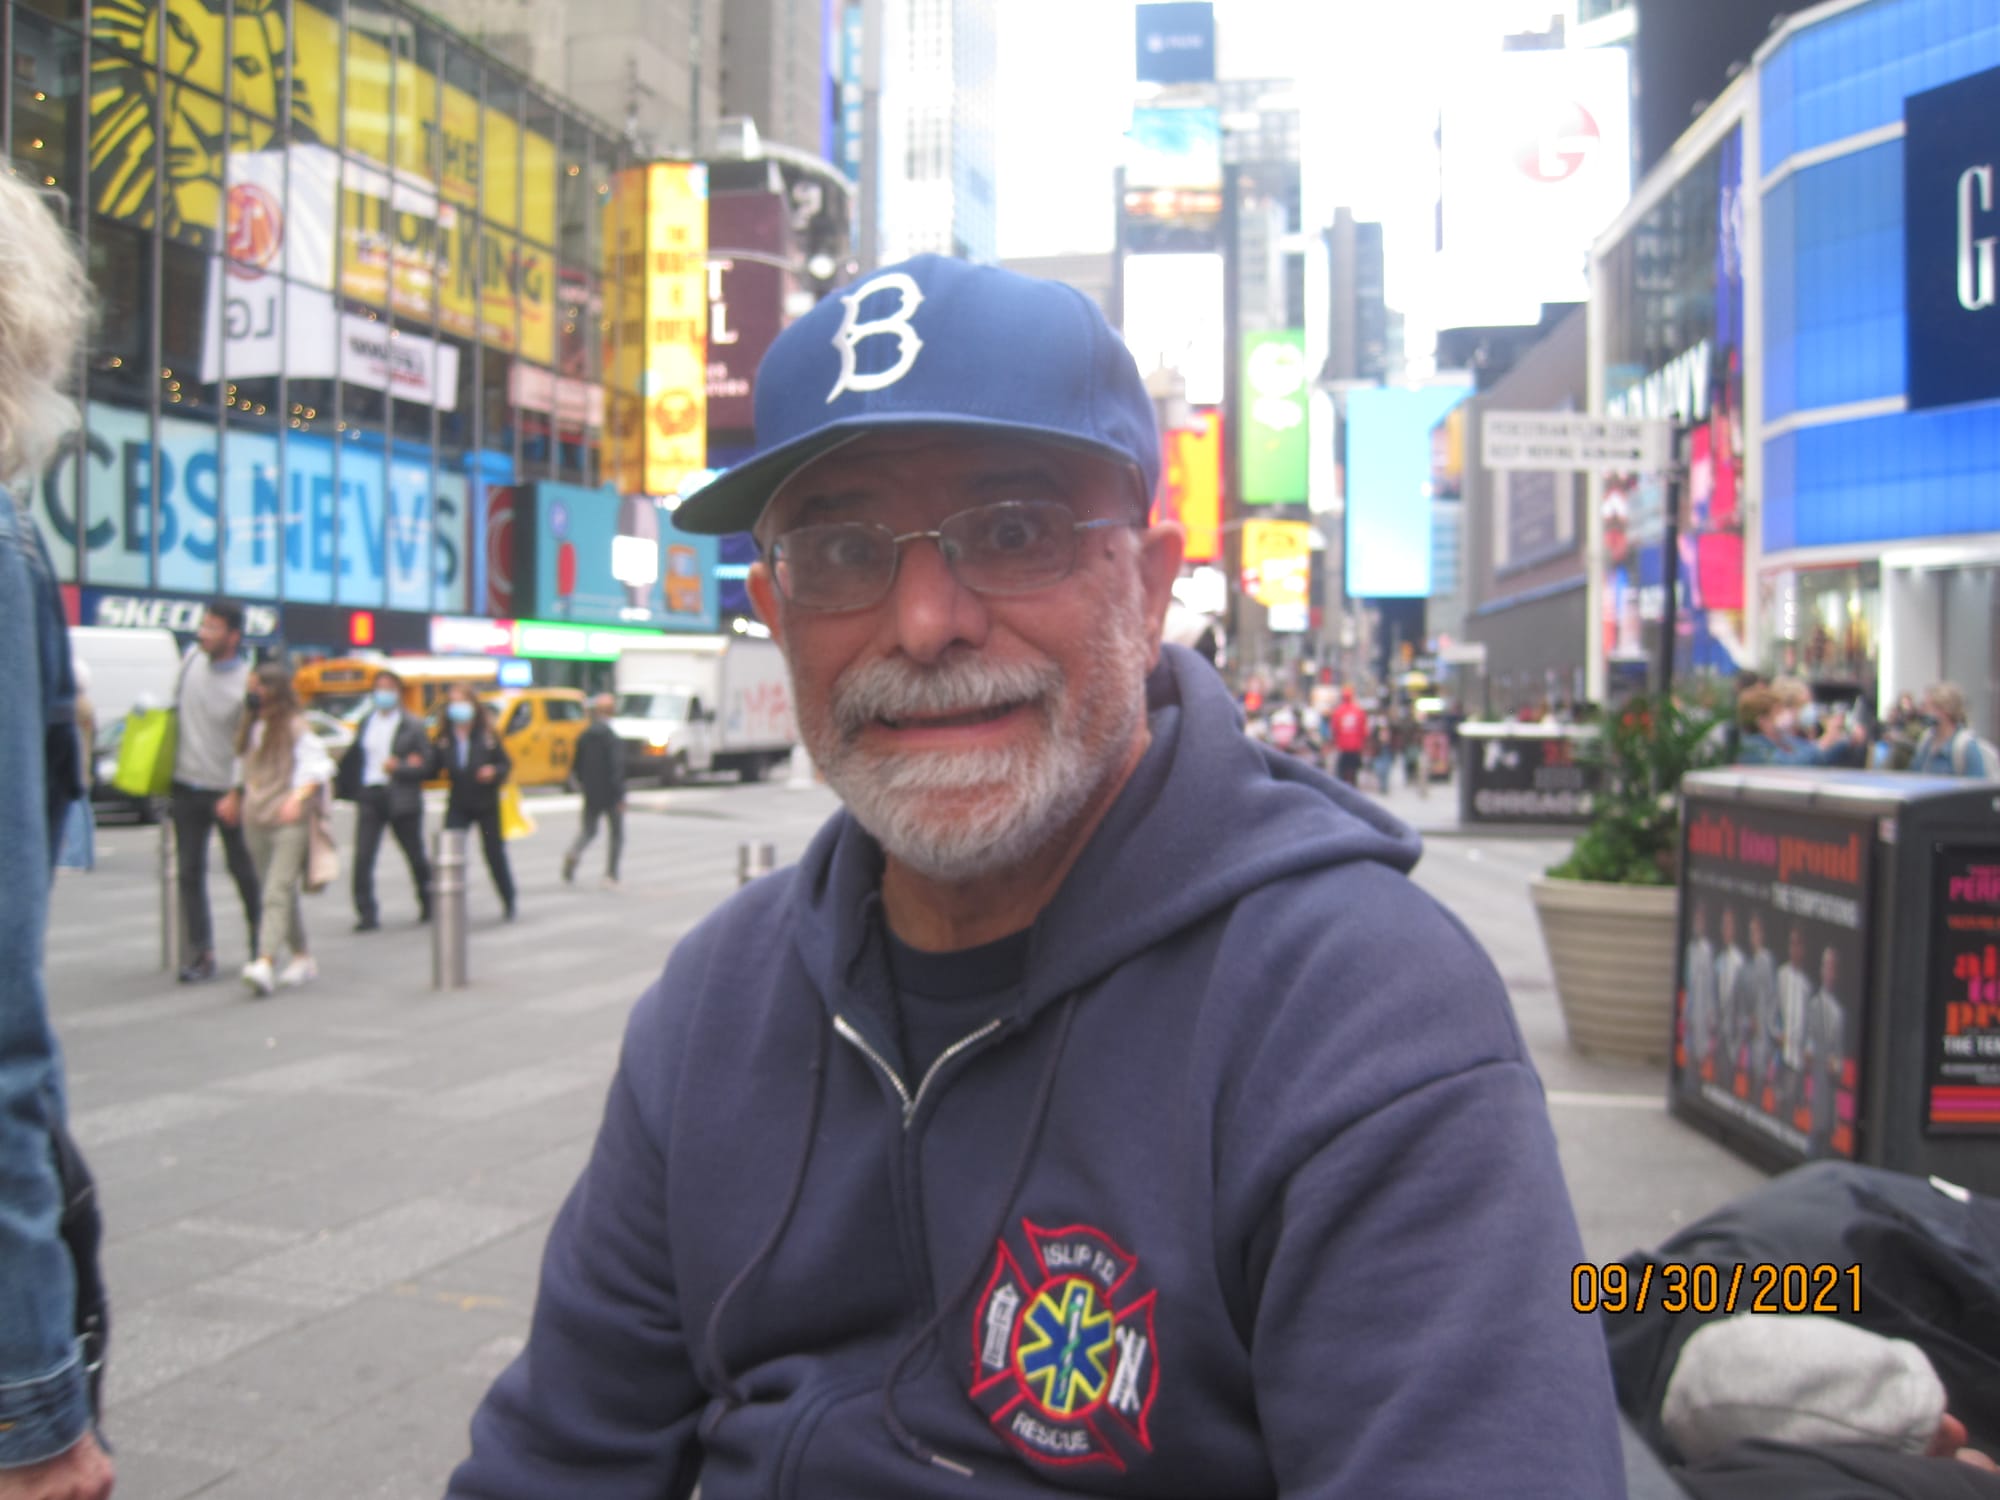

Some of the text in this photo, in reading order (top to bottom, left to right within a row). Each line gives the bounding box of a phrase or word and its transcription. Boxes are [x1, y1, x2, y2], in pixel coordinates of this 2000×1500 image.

[1957, 165, 2000, 310] G
[827, 272, 924, 404] B
[43, 430, 458, 588] CBS NEWS
[1043, 1243, 1092, 1267] ISLIP
[1012, 1410, 1090, 1453] RESCUE
